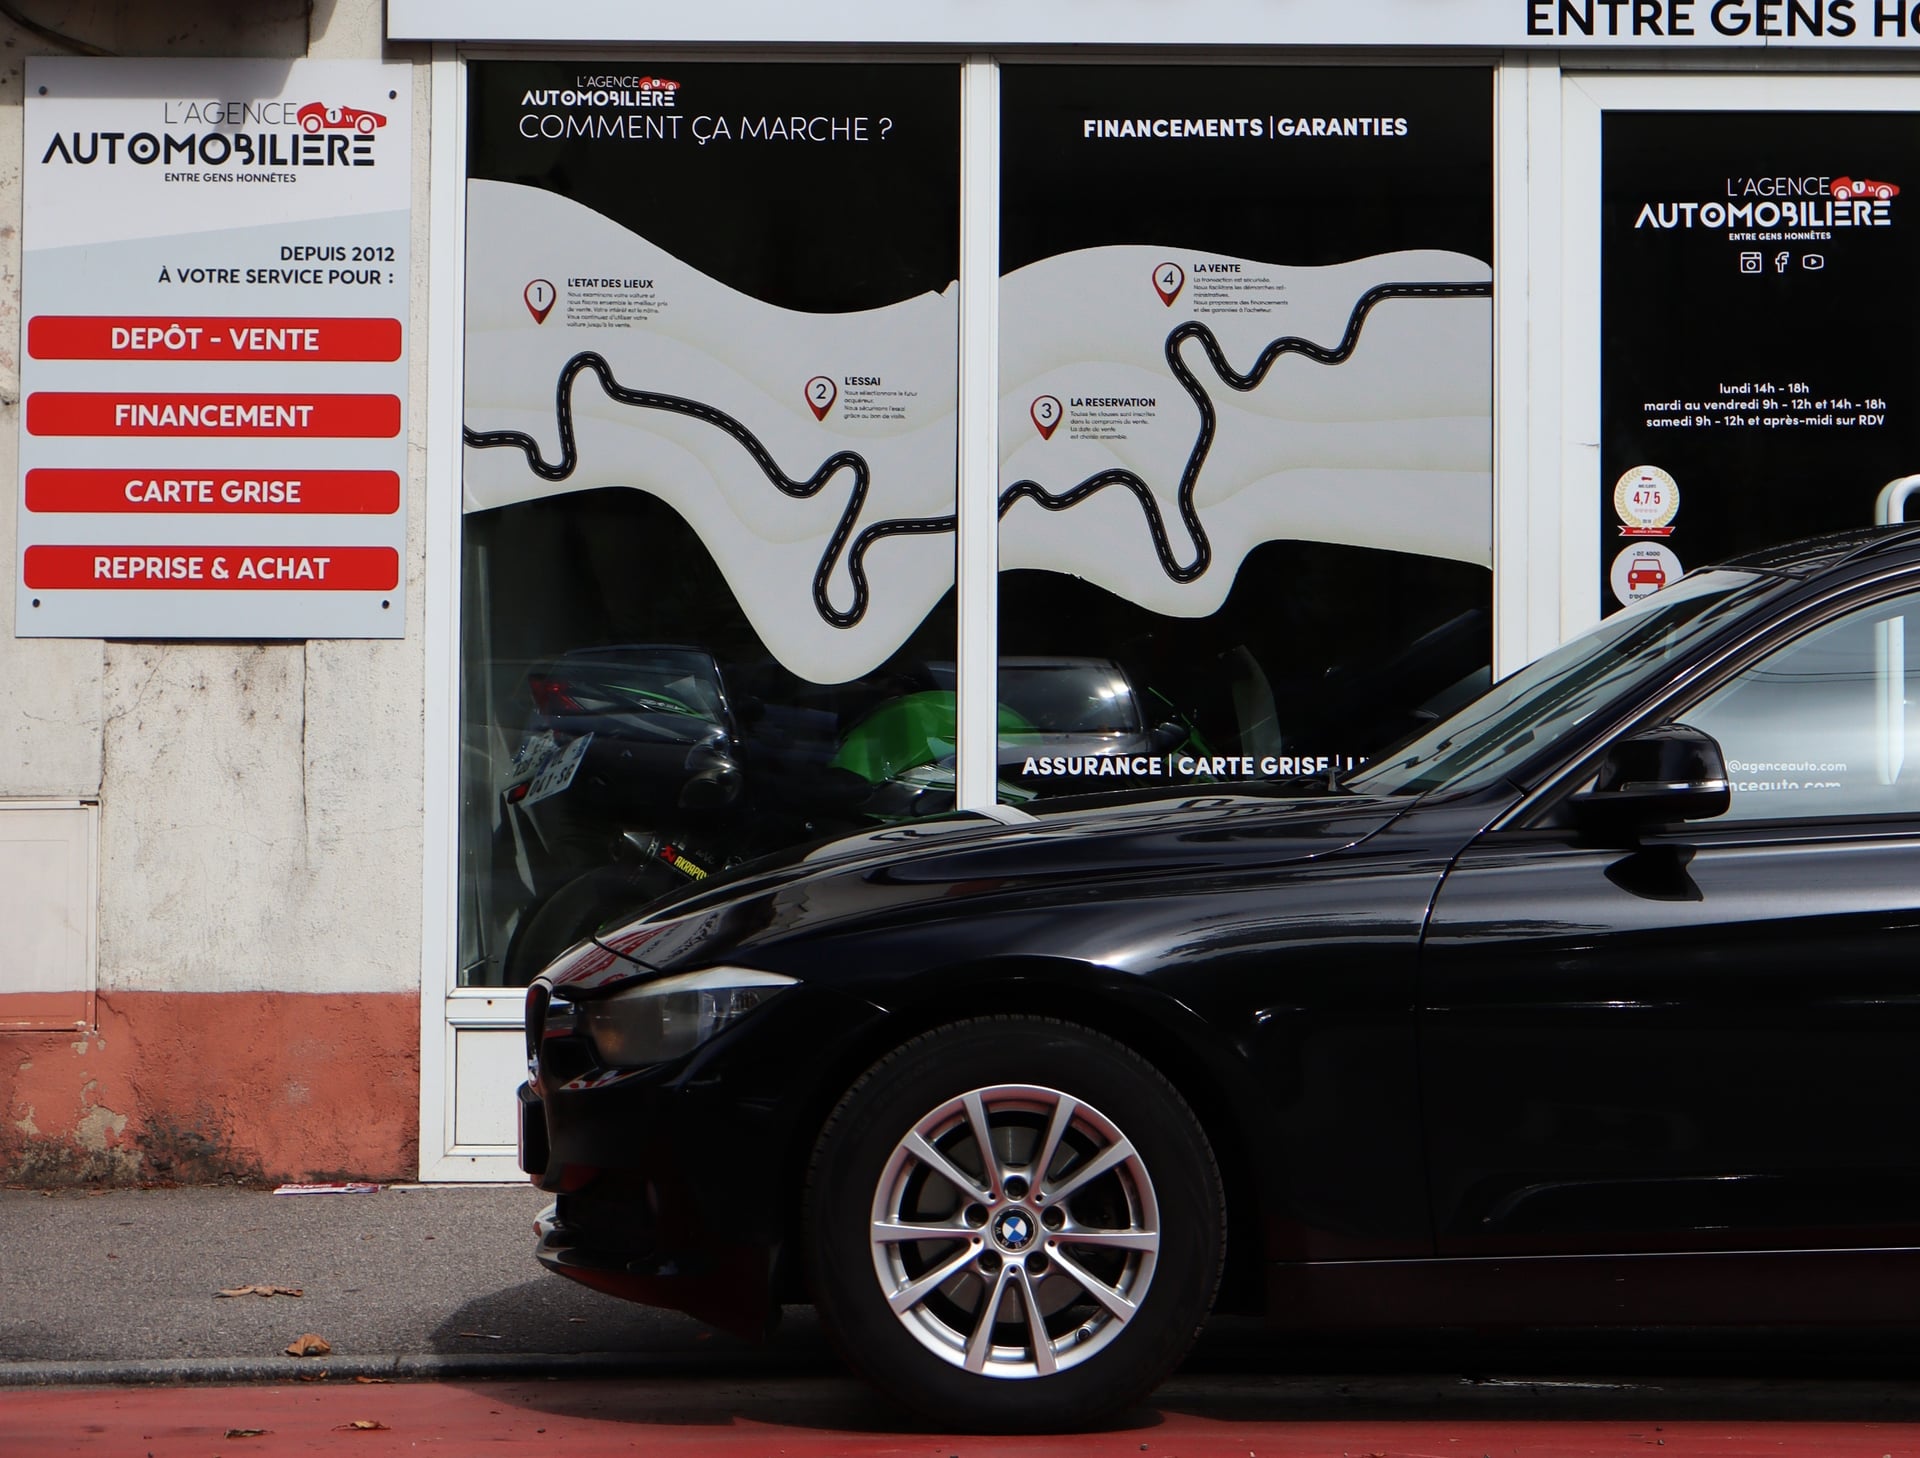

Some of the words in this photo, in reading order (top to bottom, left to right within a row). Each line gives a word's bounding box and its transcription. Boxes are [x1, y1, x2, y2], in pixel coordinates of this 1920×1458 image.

[1527, 0, 1694, 35] ENTRE
[1711, 0, 1856, 37] GENS
[578, 76, 638, 88] L'AGENCE
[165, 102, 297, 125] L'AGENCE
[519, 114, 683, 139] COMMENT
[692, 115, 731, 146] ÇA
[741, 116, 868, 142] MARCHE
[879, 117, 893, 140] ?
[1084, 118, 1263, 138] FINANCEMENTS
[1277, 117, 1408, 137] GARANTIES
[164, 173, 200, 182] ENTRE
[203, 173, 233, 183] GENS
[236, 171, 297, 183] HONNÊTES
[1728, 177, 1830, 197] L'AGENCE
[1729, 232, 1757, 240] ENTRE
[1759, 232, 1782, 240] GENS
[1784, 230, 1831, 240] HONNÊTES
[280, 246, 347, 262] DEPUIS
[352, 246, 395, 262] 2012
[158, 265, 171, 283] À
[177, 268, 241, 284] VOTRE
[246, 269, 323, 285] SERVICE
[328, 269, 381, 285] POUR
[1194, 264, 1207, 273] LA
[1208, 264, 1241, 273] VENTE
[568, 279, 599, 288] L'ETAT
[601, 279, 622, 288] DES
[624, 280, 654, 288] LIEUX
[1163, 270, 1174, 285] 4
[111, 323, 203, 350] DEPÔT
[229, 328, 320, 351] VENTE
[844, 376, 881, 386] L'ESSAI
[1719, 382, 1751, 394] lundi
[1753, 382, 1775, 394] 14h
[1787, 382, 1810, 394] 18h
[816, 383, 827, 400] 2
[1041, 402, 1052, 419] 3
[1070, 398, 1083, 407] LA
[1086, 398, 1156, 407] RESERVATION
[1644, 399, 1681, 411] mardi
[1684, 402, 1701, 411] au
[1703, 398, 1759, 410] vendredi
[1762, 398, 1779, 410] 9h
[1791, 398, 1812, 410] 12h
[1814, 399, 1828, 410] et
[1830, 398, 1852, 409] 14h
[1864, 398, 1886, 410] 18h
[115, 404, 314, 427] FINANCEMENT
[1646, 415, 1692, 427] samedi
[1695, 415, 1712, 427] 9h
[1724, 414, 1745, 426] 12h
[1747, 415, 1760, 426] et
[1763, 414, 1833, 429] après-midi
[1836, 417, 1856, 426] sur
[1858, 414, 1885, 426] RDV
[124, 480, 214, 503] CARTE
[220, 480, 301, 503] GRISE
[94, 557, 204, 579] REPRISE
[210, 557, 230, 579] &
[237, 557, 331, 580] ACHAT
[1021, 757, 1162, 776] ASSURANCE
[1178, 757, 1254, 775] CARTE
